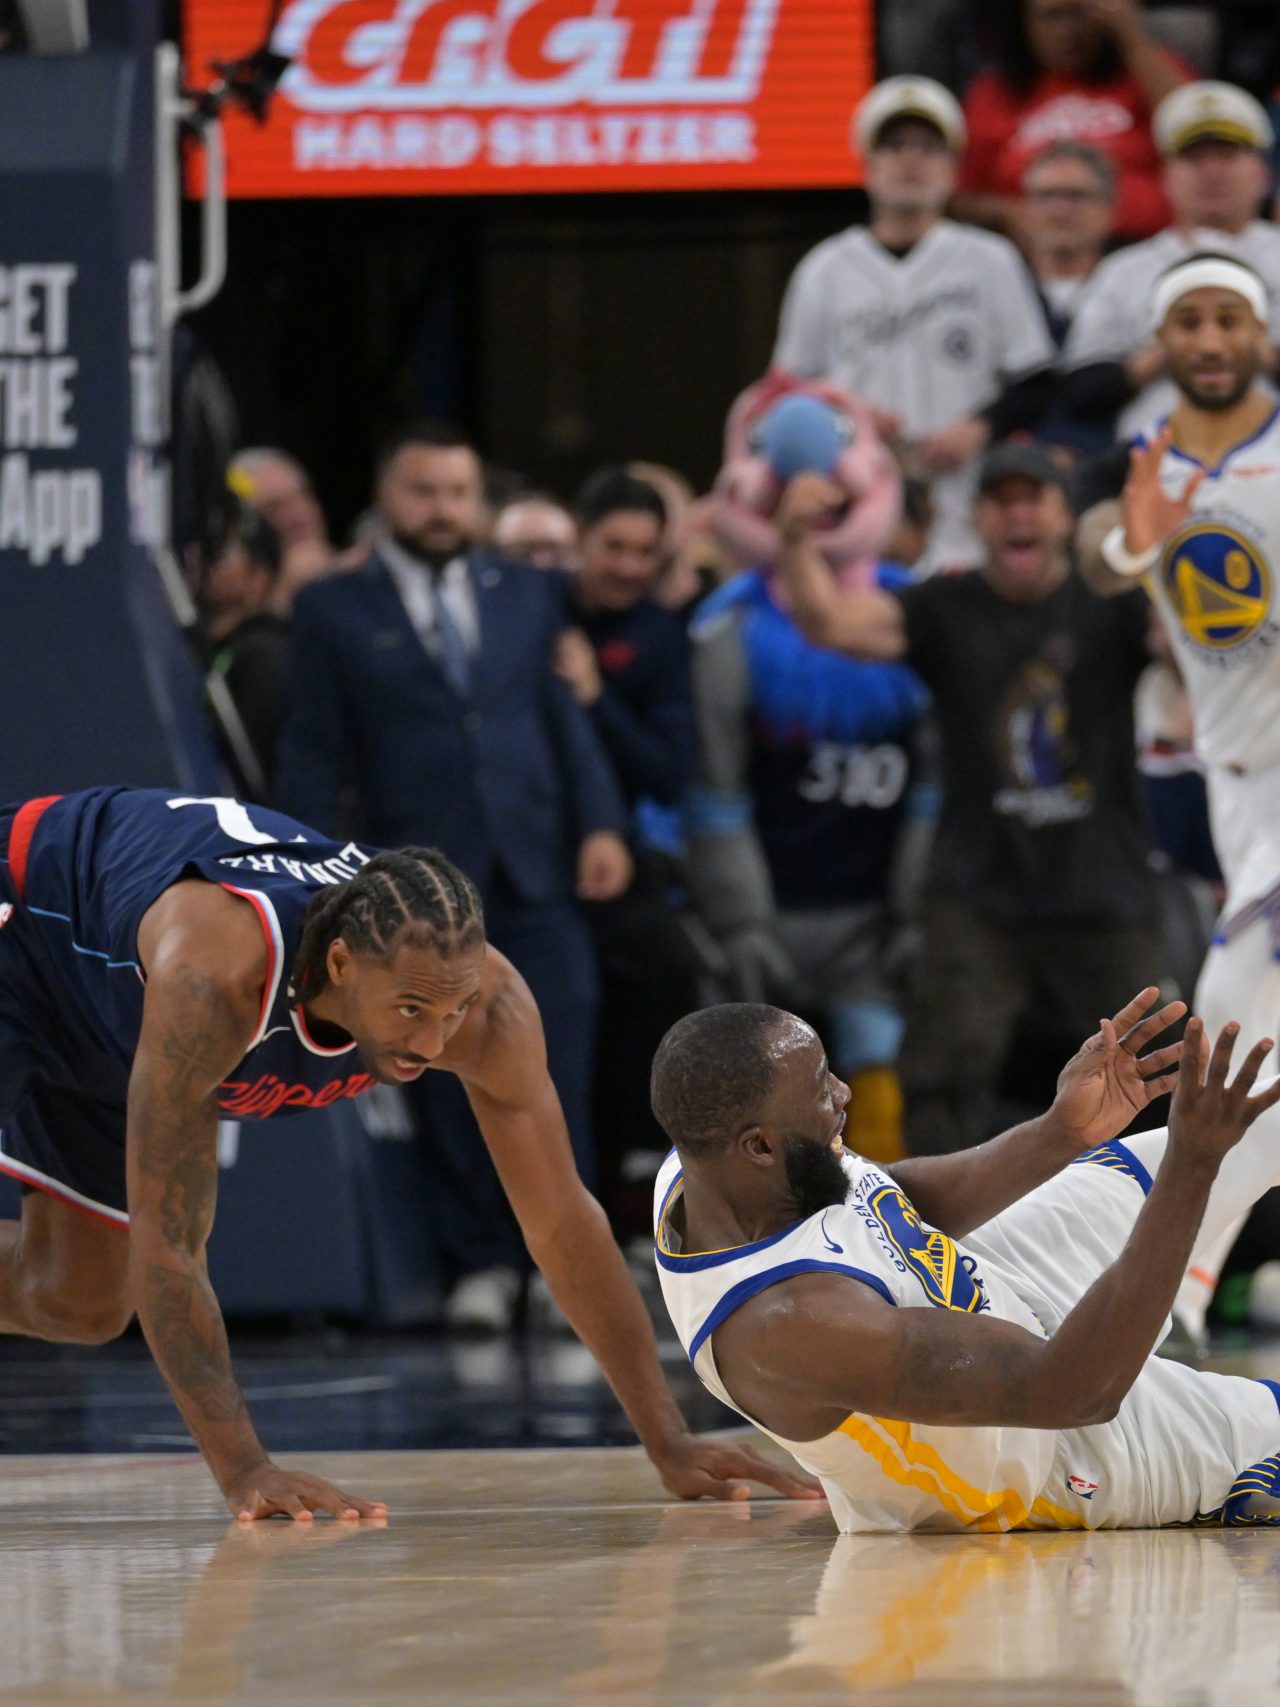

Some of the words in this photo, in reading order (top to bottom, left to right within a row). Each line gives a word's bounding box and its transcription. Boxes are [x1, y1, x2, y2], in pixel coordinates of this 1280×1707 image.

[293, 114, 480, 169] HARD
[487, 111, 757, 165] SELTZER
[0, 452, 102, 567] App
[854, 1172, 885, 1202] STATE
